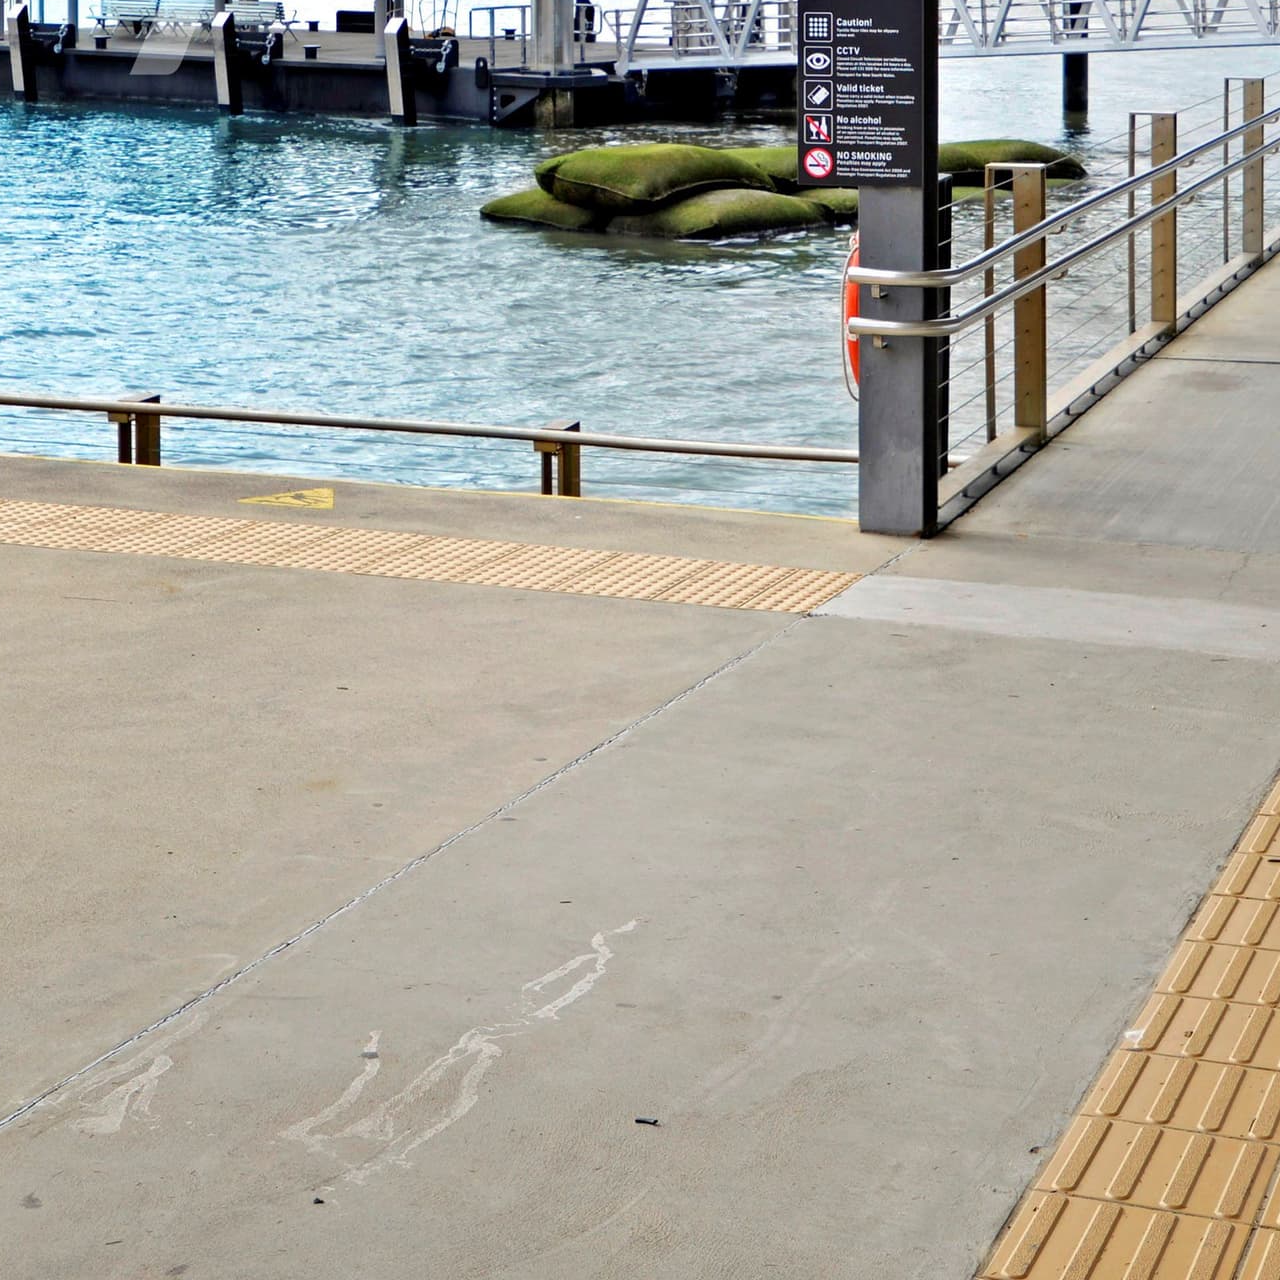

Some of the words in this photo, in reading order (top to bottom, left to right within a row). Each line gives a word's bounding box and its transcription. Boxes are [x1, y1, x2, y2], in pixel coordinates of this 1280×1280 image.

[836, 18, 873, 27] Caution!
[836, 46, 860, 55] CCTV
[836, 83, 858, 92] Valid
[859, 84, 885, 93] ticket
[836, 115, 849, 124] No
[850, 115, 882, 125] alcohol
[836, 151, 850, 160] NO
[851, 151, 893, 161] SMOKING
